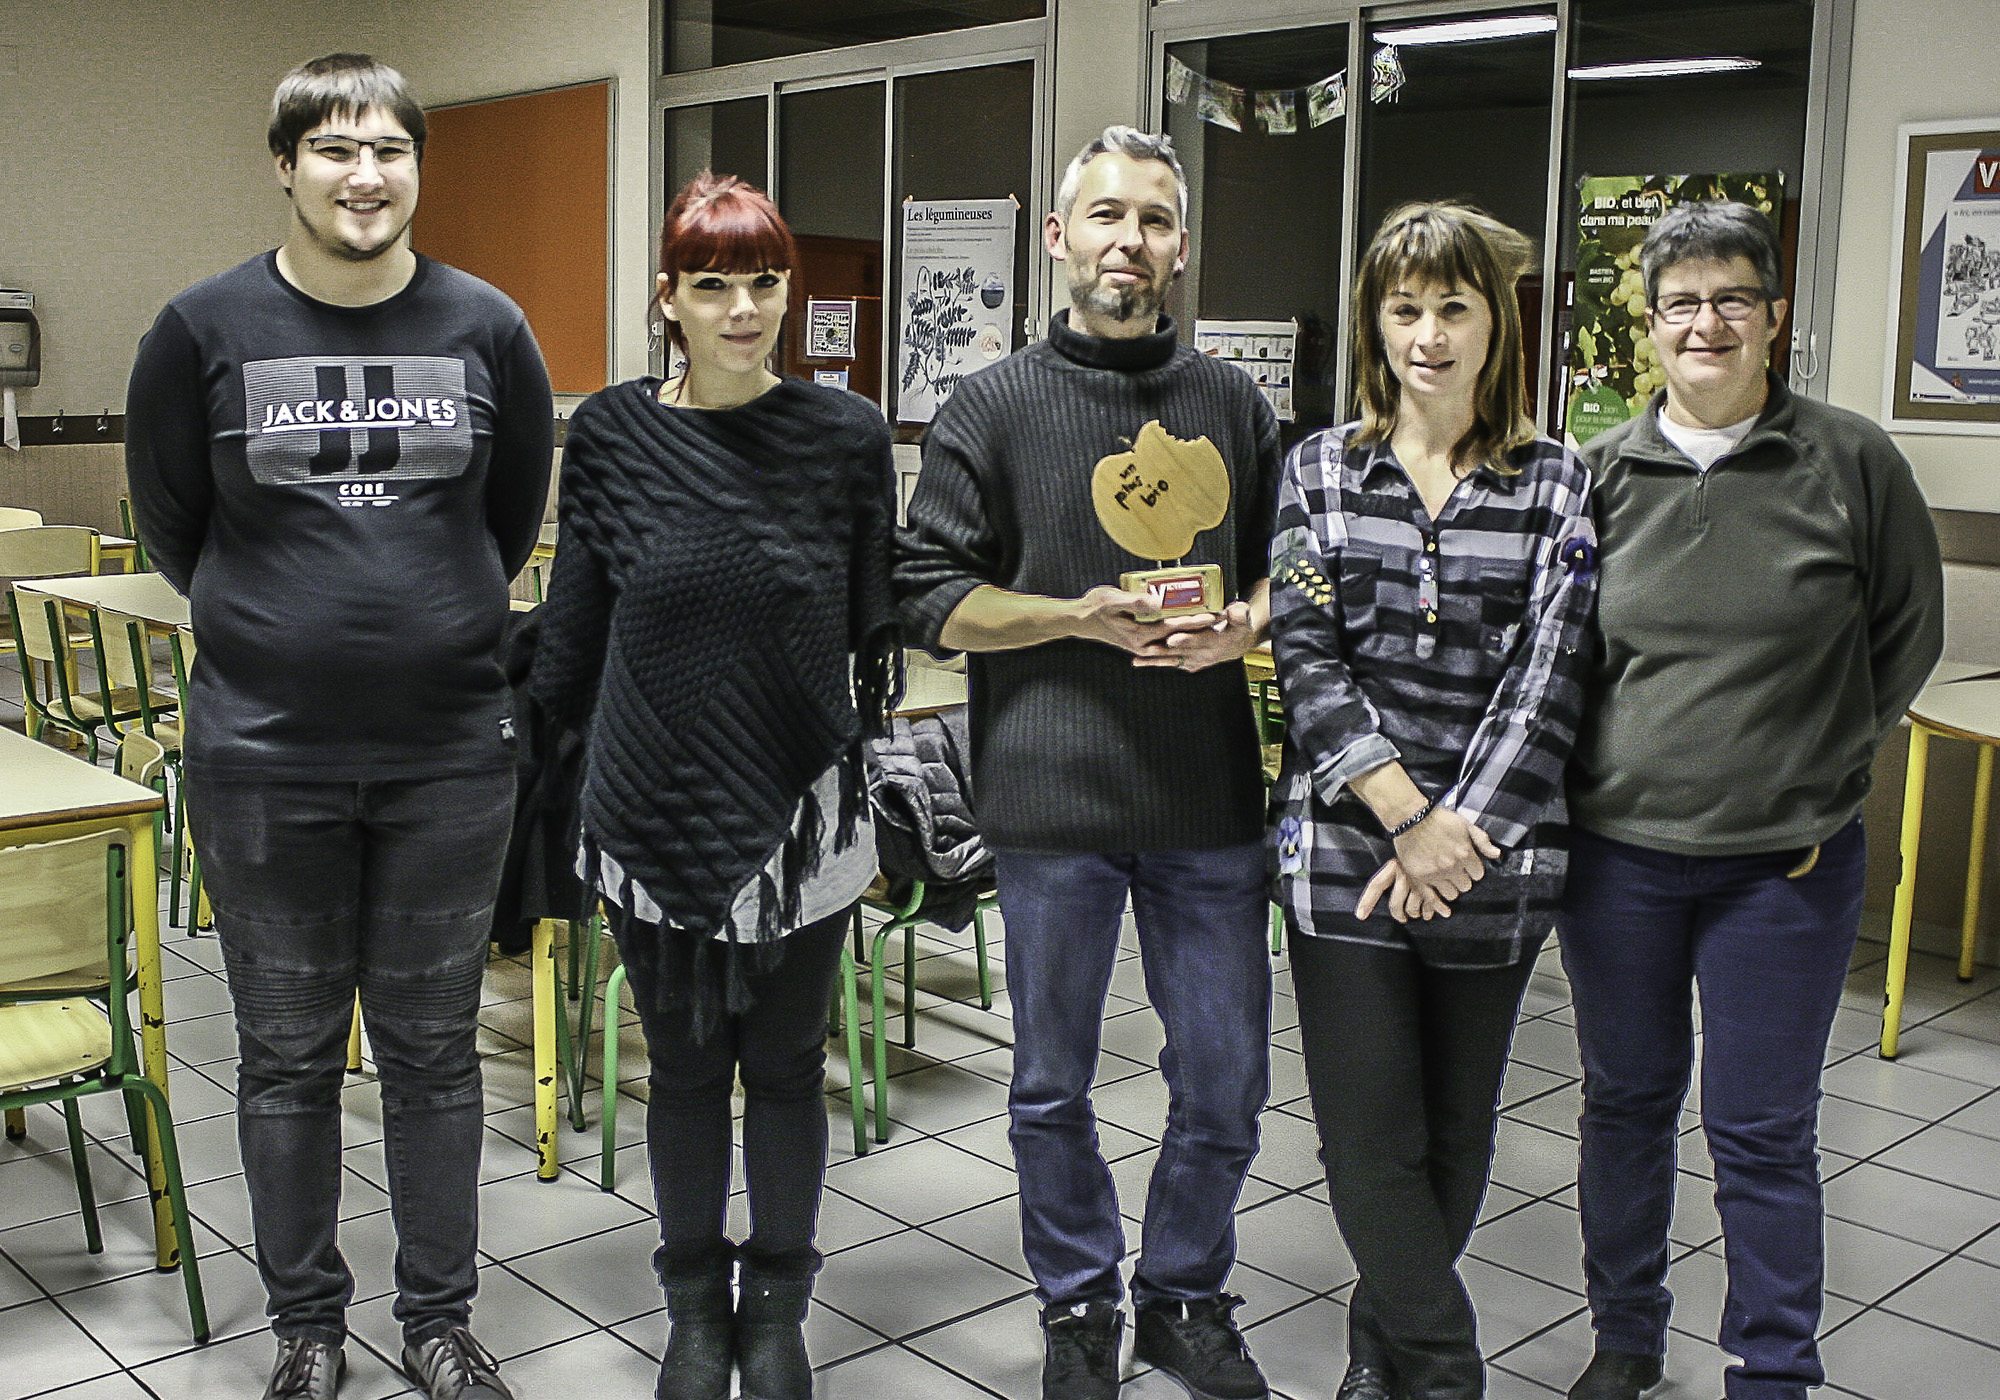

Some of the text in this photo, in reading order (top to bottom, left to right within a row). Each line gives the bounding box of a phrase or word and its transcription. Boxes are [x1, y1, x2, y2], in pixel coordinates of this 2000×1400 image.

[1594, 196, 1659, 210] BIO, et bien
[906, 206, 993, 224] Les légumineuses
[1580, 214, 1606, 227] dans
[1607, 215, 1625, 226] ma
[262, 397, 457, 428] JACK & JONES
[338, 482, 385, 496] CORE
[1140, 479, 1169, 508] bio
